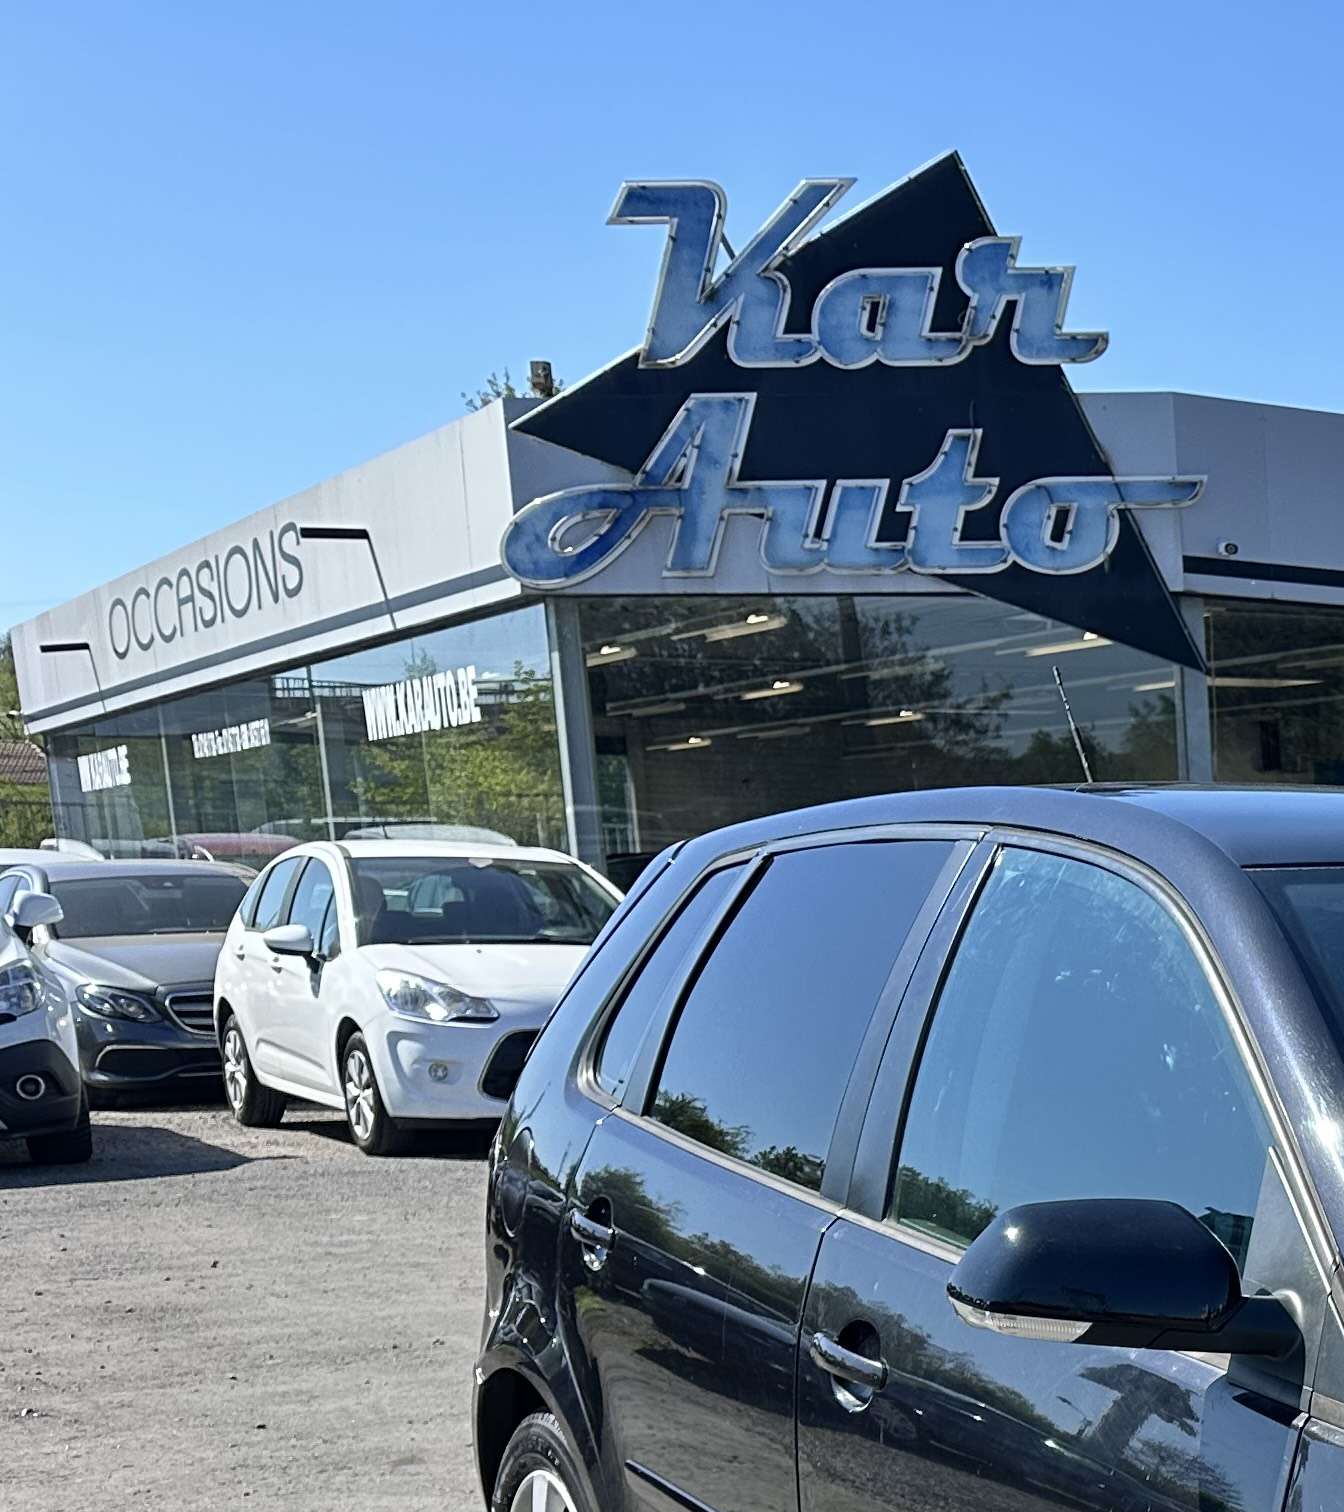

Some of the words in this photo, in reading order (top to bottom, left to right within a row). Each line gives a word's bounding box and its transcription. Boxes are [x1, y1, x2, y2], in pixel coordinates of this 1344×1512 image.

[605, 177, 1110, 369] Kar
[499, 391, 1209, 588] Auto
[108, 521, 303, 660] OCCASIONS
[361, 665, 482, 742] WWW.KARAUTO.BE
